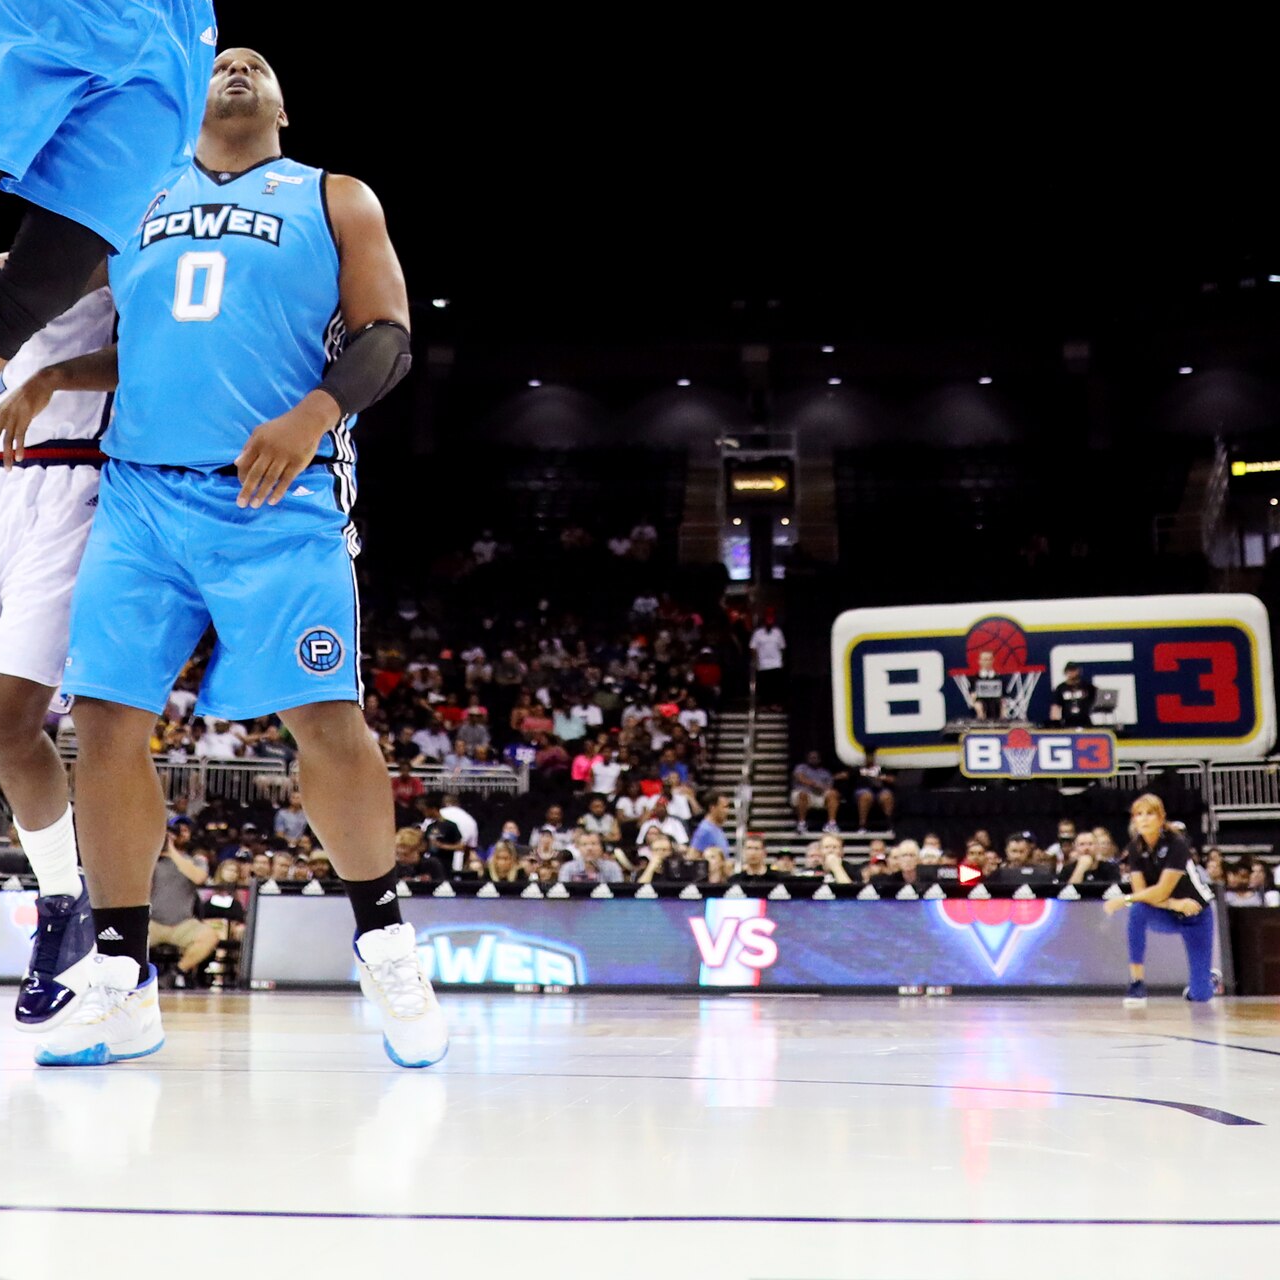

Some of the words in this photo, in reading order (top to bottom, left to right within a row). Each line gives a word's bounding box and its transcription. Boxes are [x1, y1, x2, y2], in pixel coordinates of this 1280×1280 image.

[141, 204, 282, 249] POWER
[172, 251, 226, 322] 0
[688, 916, 779, 969] VS
